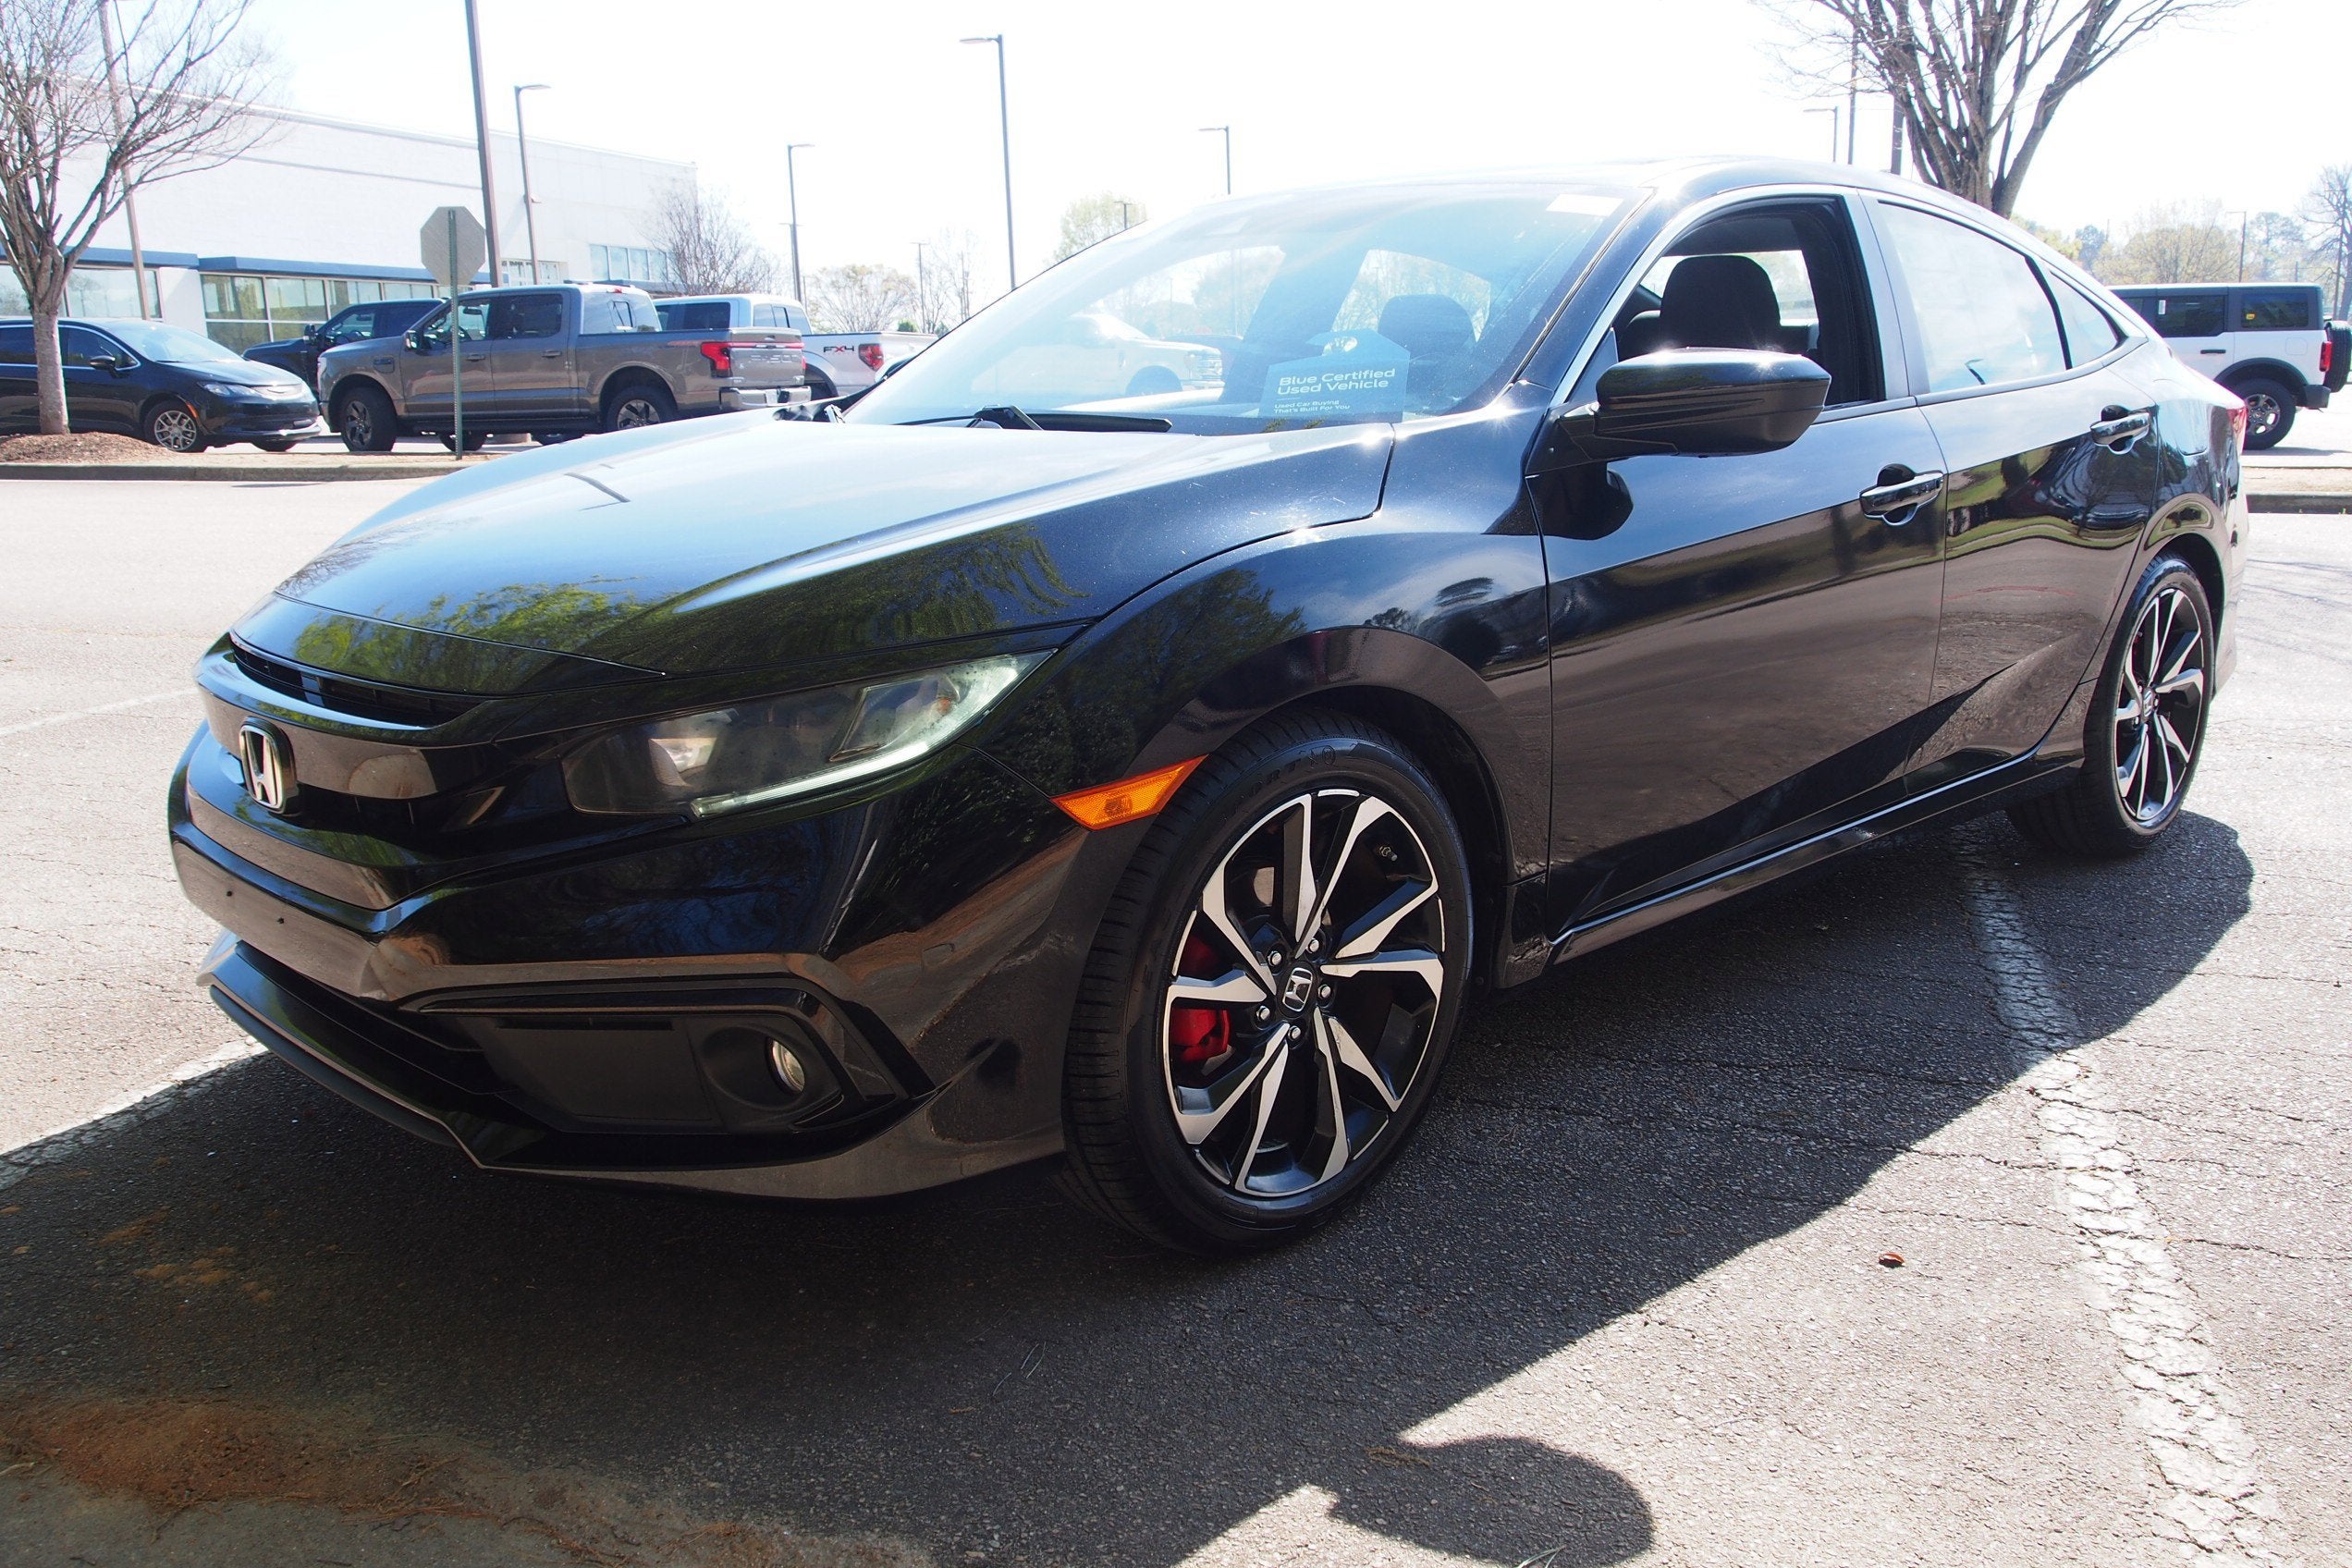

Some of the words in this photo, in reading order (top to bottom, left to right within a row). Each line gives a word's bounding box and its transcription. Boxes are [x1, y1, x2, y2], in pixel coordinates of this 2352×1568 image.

[1280, 376, 1317, 386] Blue
[1321, 368, 1396, 382] Certified
[1277, 384, 1322, 395] Used
[1326, 379, 1390, 391] Vehicle
